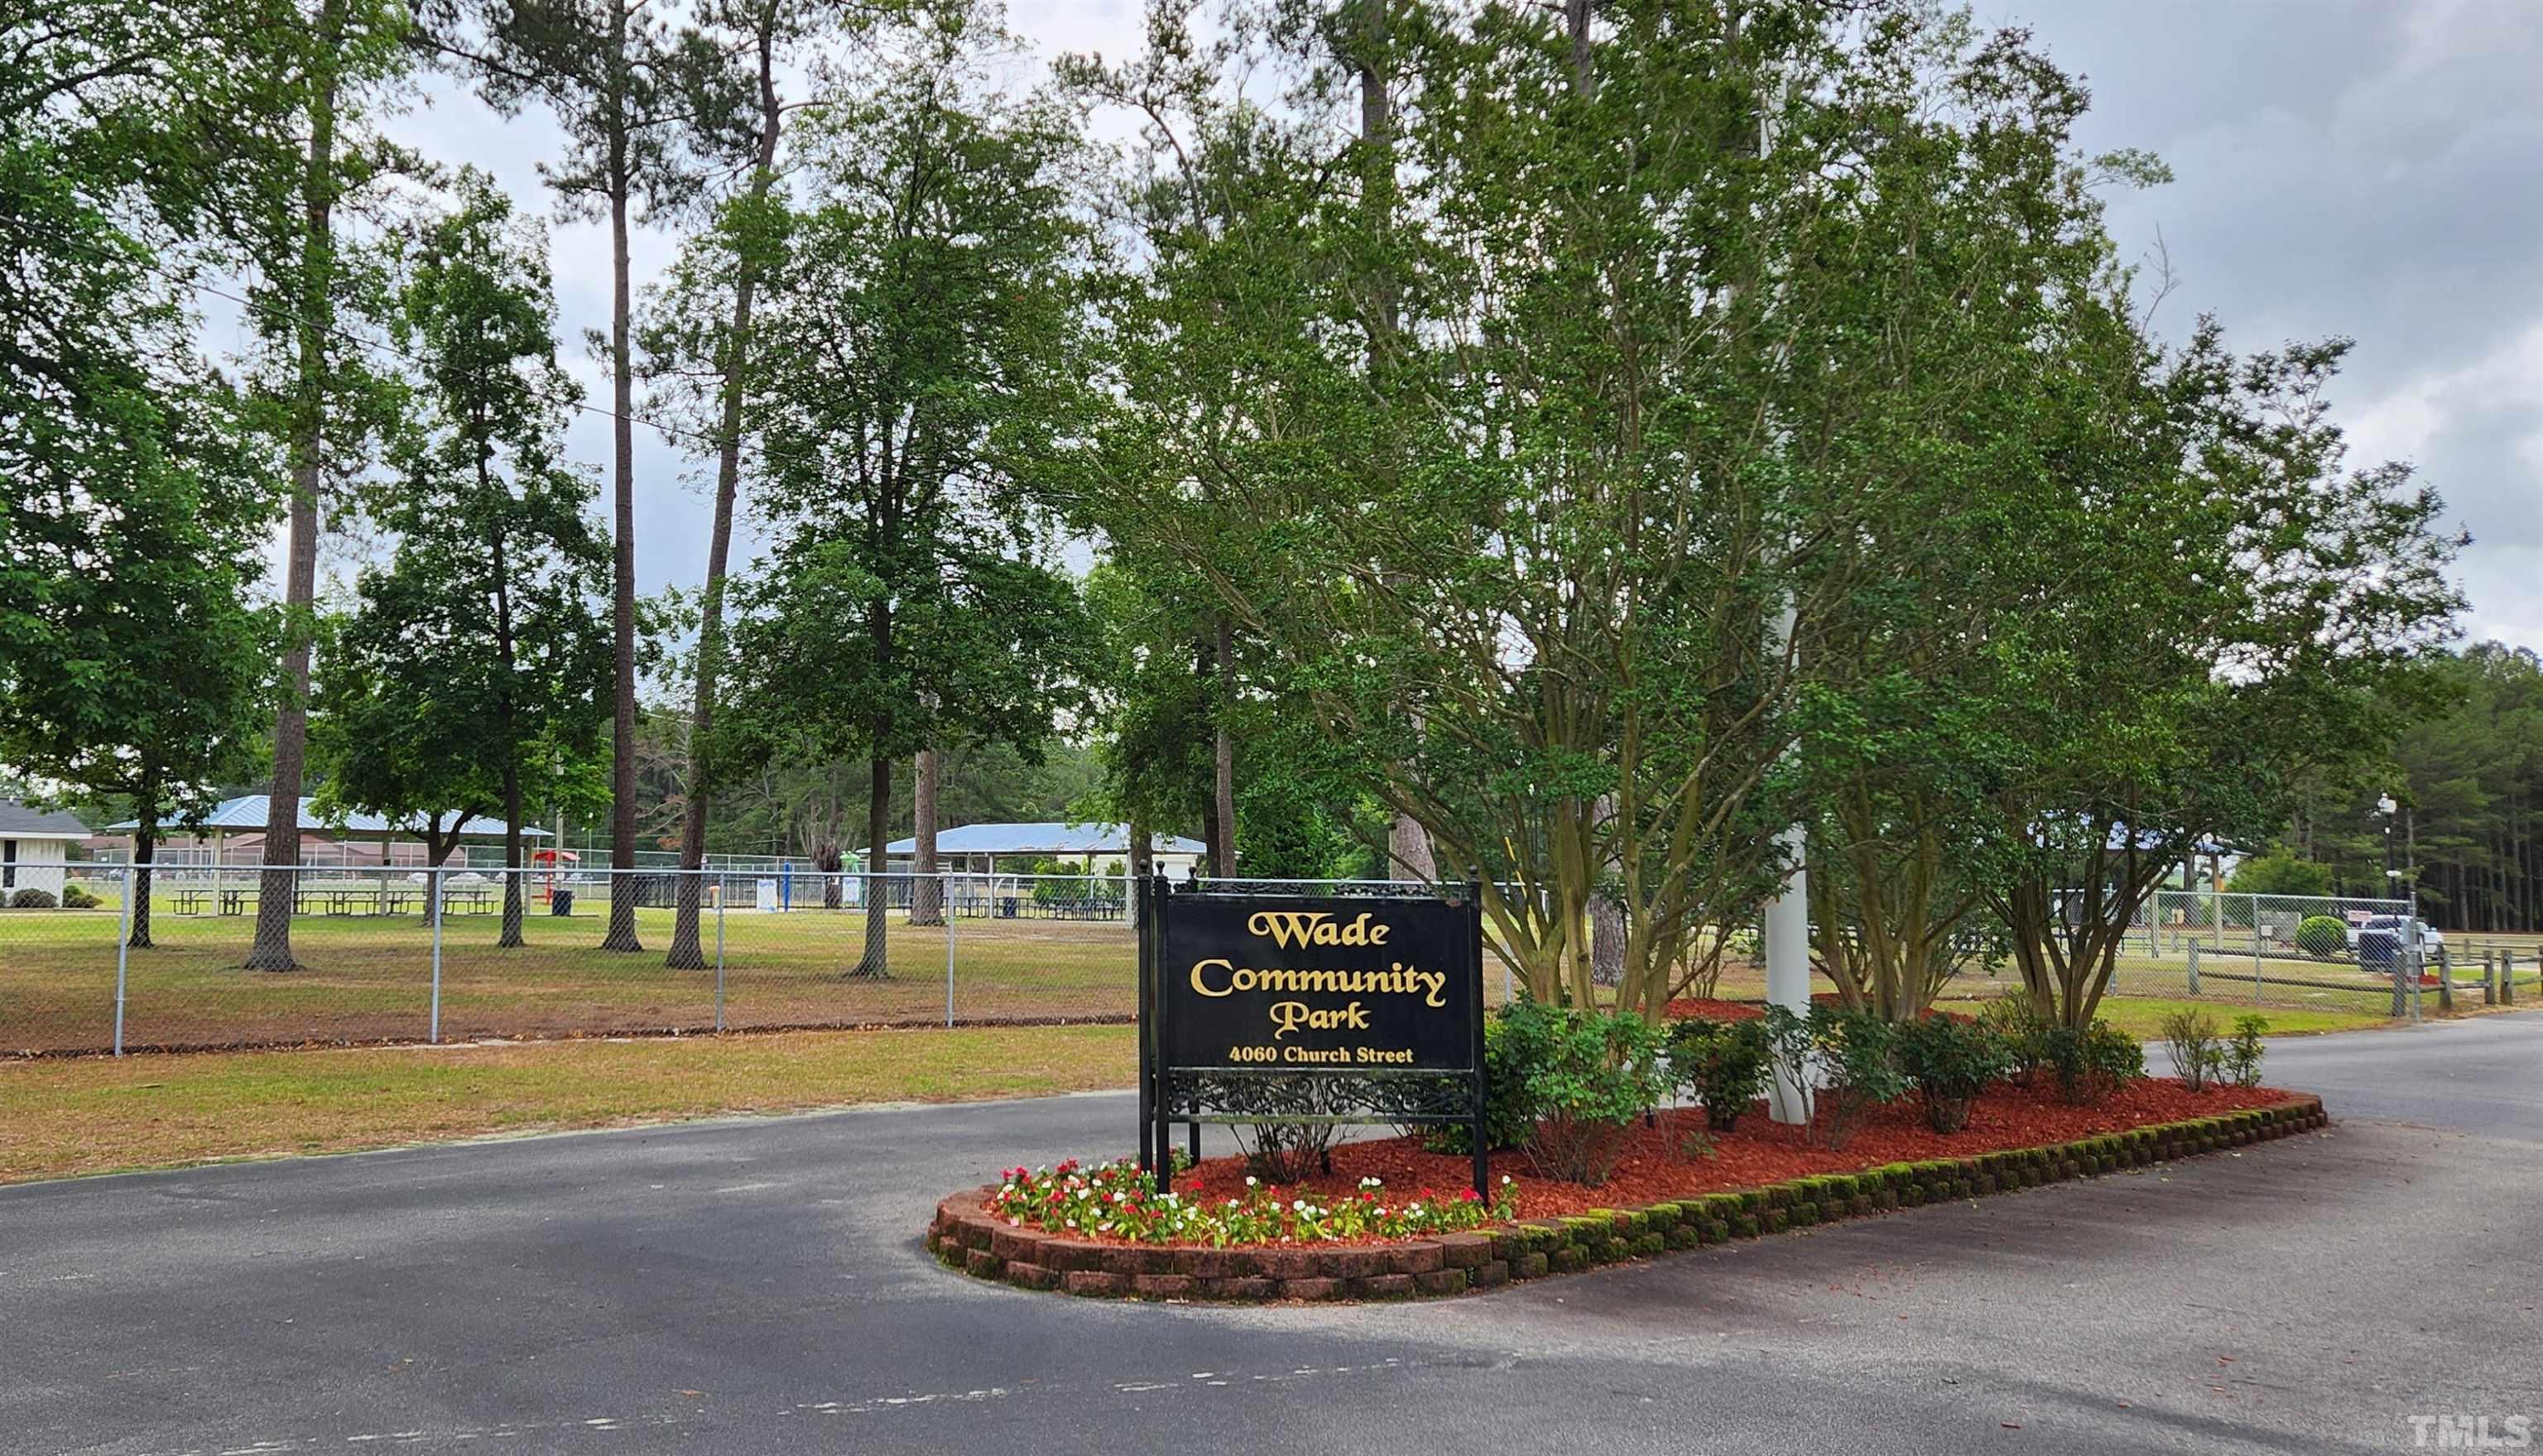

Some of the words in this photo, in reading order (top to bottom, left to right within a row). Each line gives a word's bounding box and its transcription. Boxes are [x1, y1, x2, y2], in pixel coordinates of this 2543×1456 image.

[1247, 911, 1390, 949] Wade
[1190, 959, 1446, 1007] Community
[1270, 1001, 1371, 1040] Park
[1229, 1045, 1277, 1062] 4060
[1284, 1046, 1351, 1063] Church
[1357, 1046, 1414, 1063] Street
